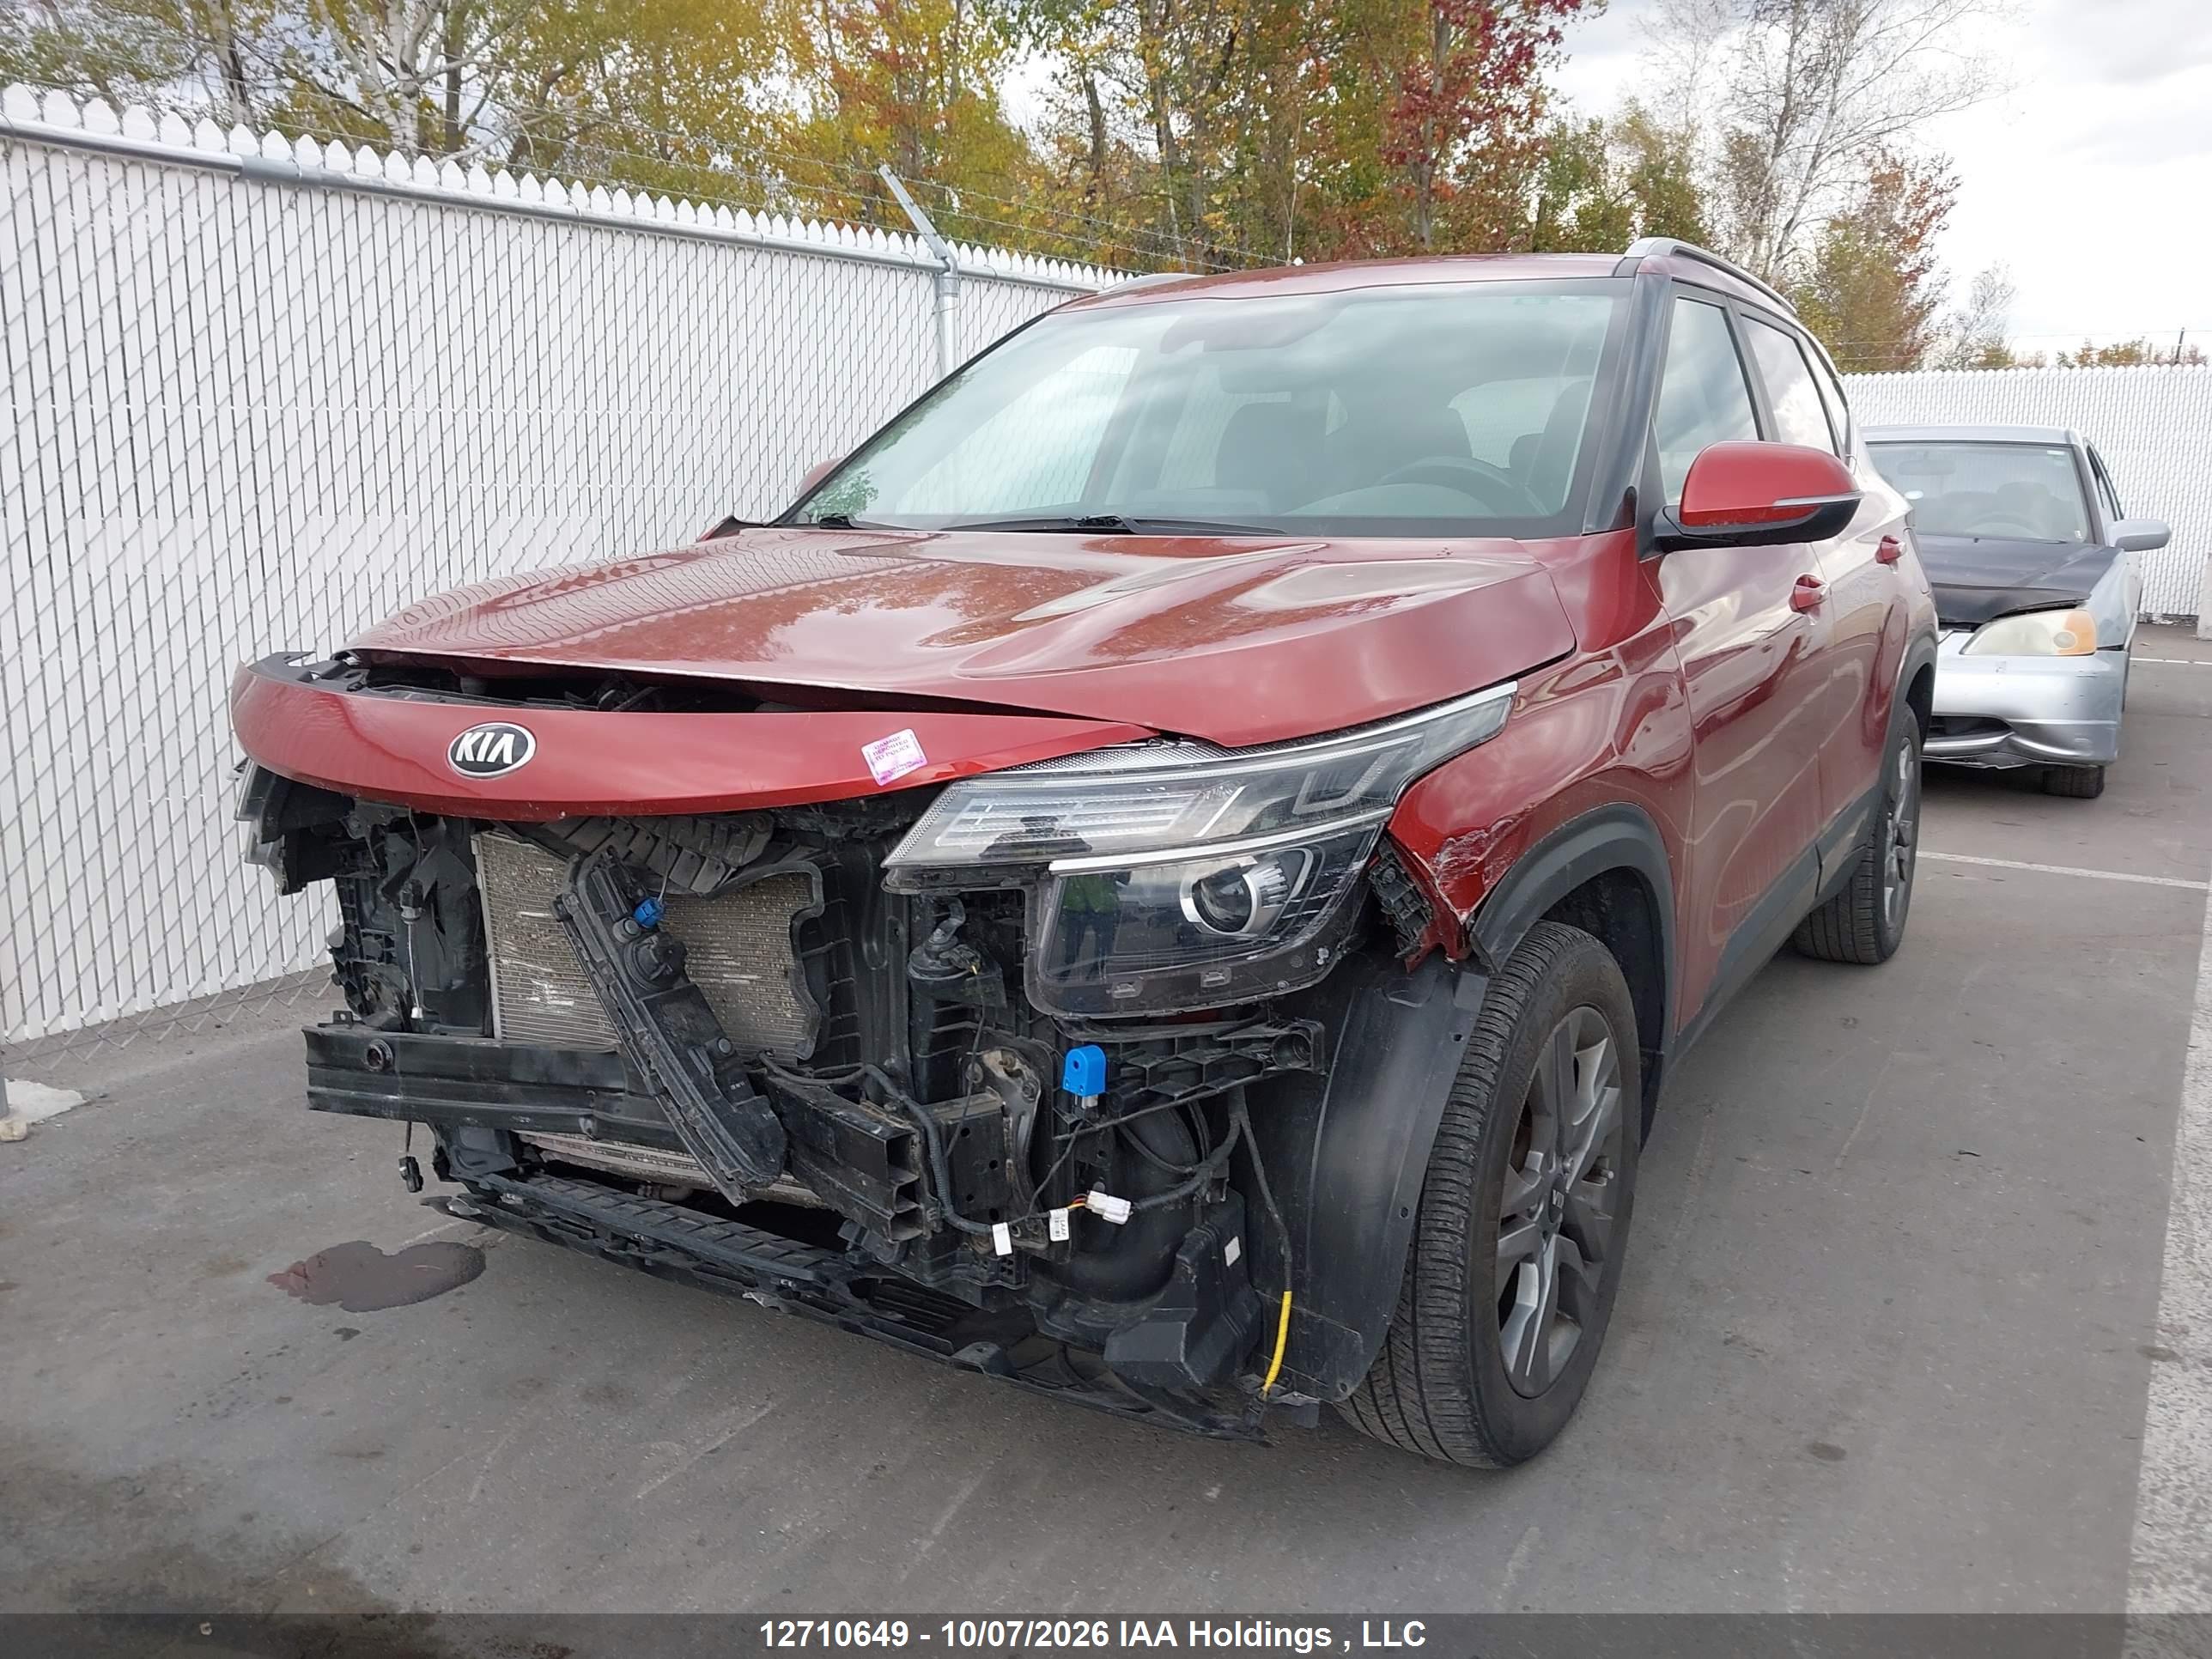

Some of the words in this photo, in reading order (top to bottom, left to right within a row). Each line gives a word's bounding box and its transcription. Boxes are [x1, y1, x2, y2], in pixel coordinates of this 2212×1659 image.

[455, 732, 515, 764] KIA
[872, 739, 909, 756] REPORTED
[885, 744, 910, 757] POLICE
